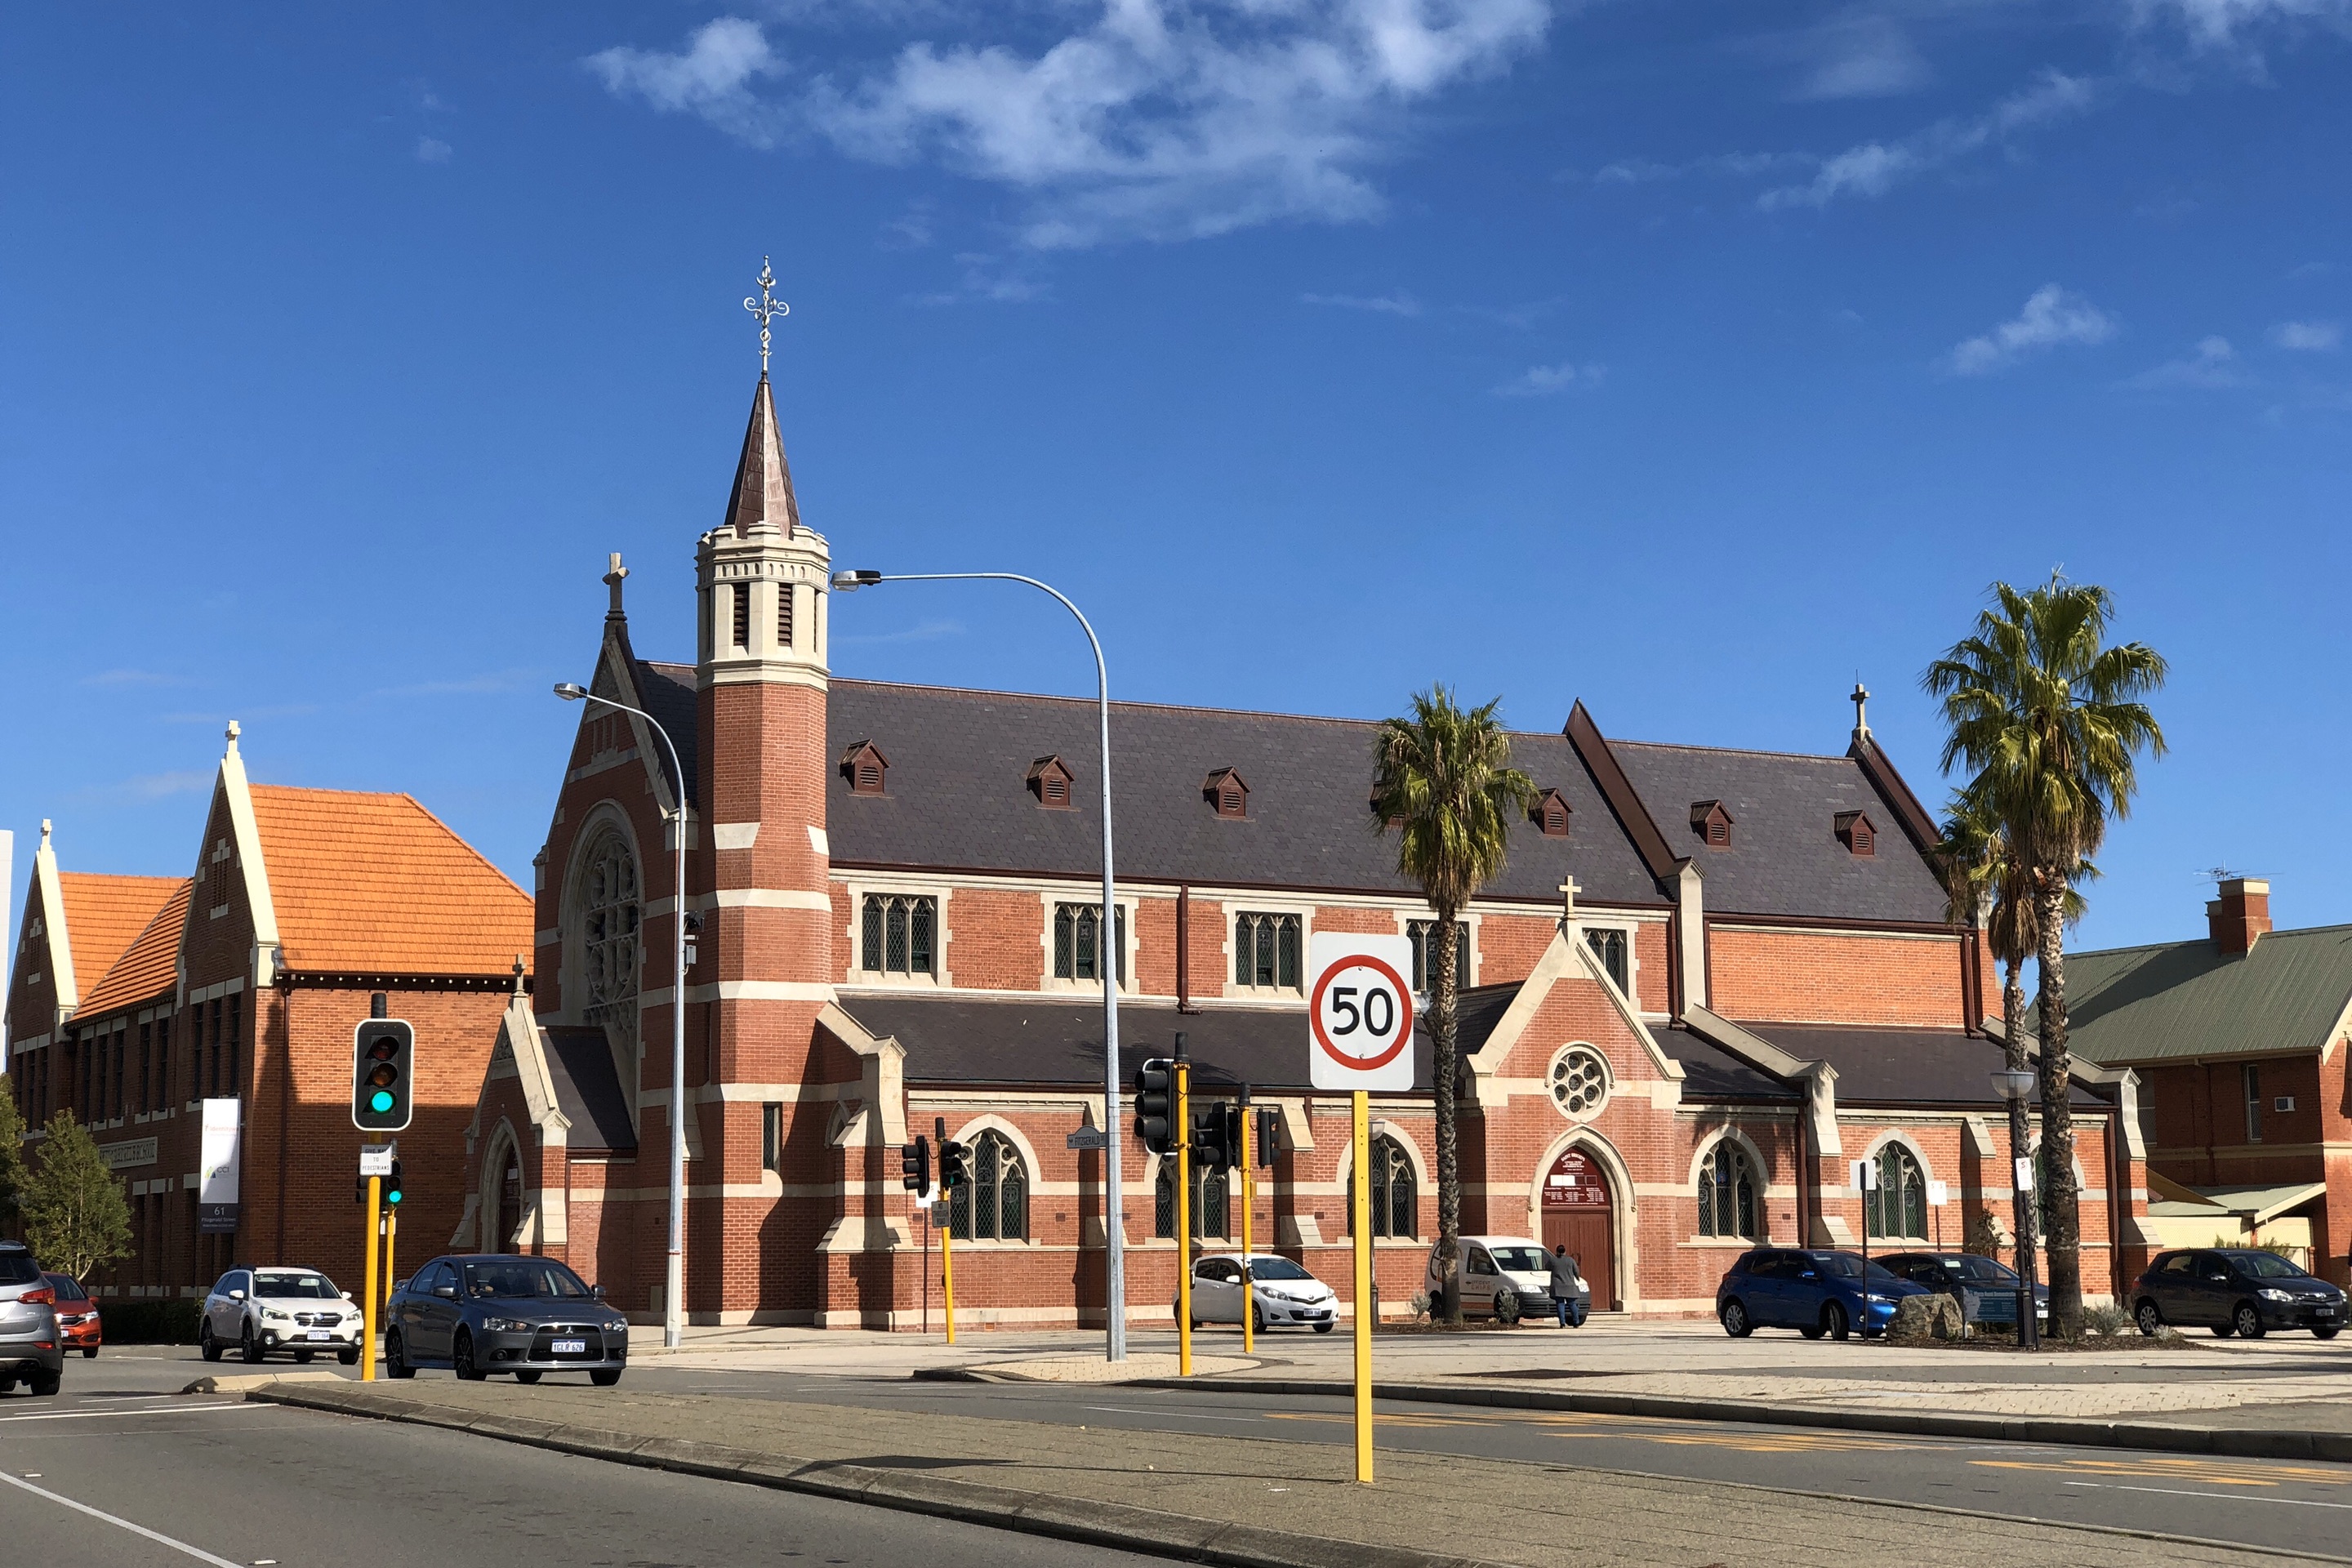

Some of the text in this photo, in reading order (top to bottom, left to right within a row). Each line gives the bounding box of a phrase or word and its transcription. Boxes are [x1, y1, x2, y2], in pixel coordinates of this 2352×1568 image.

[1332, 987, 1393, 1036] 50
[1075, 1136, 1100, 1146] FITZGERALD
[214, 1206, 225, 1216] 61
[554, 1343, 583, 1352] 1GLR 626
